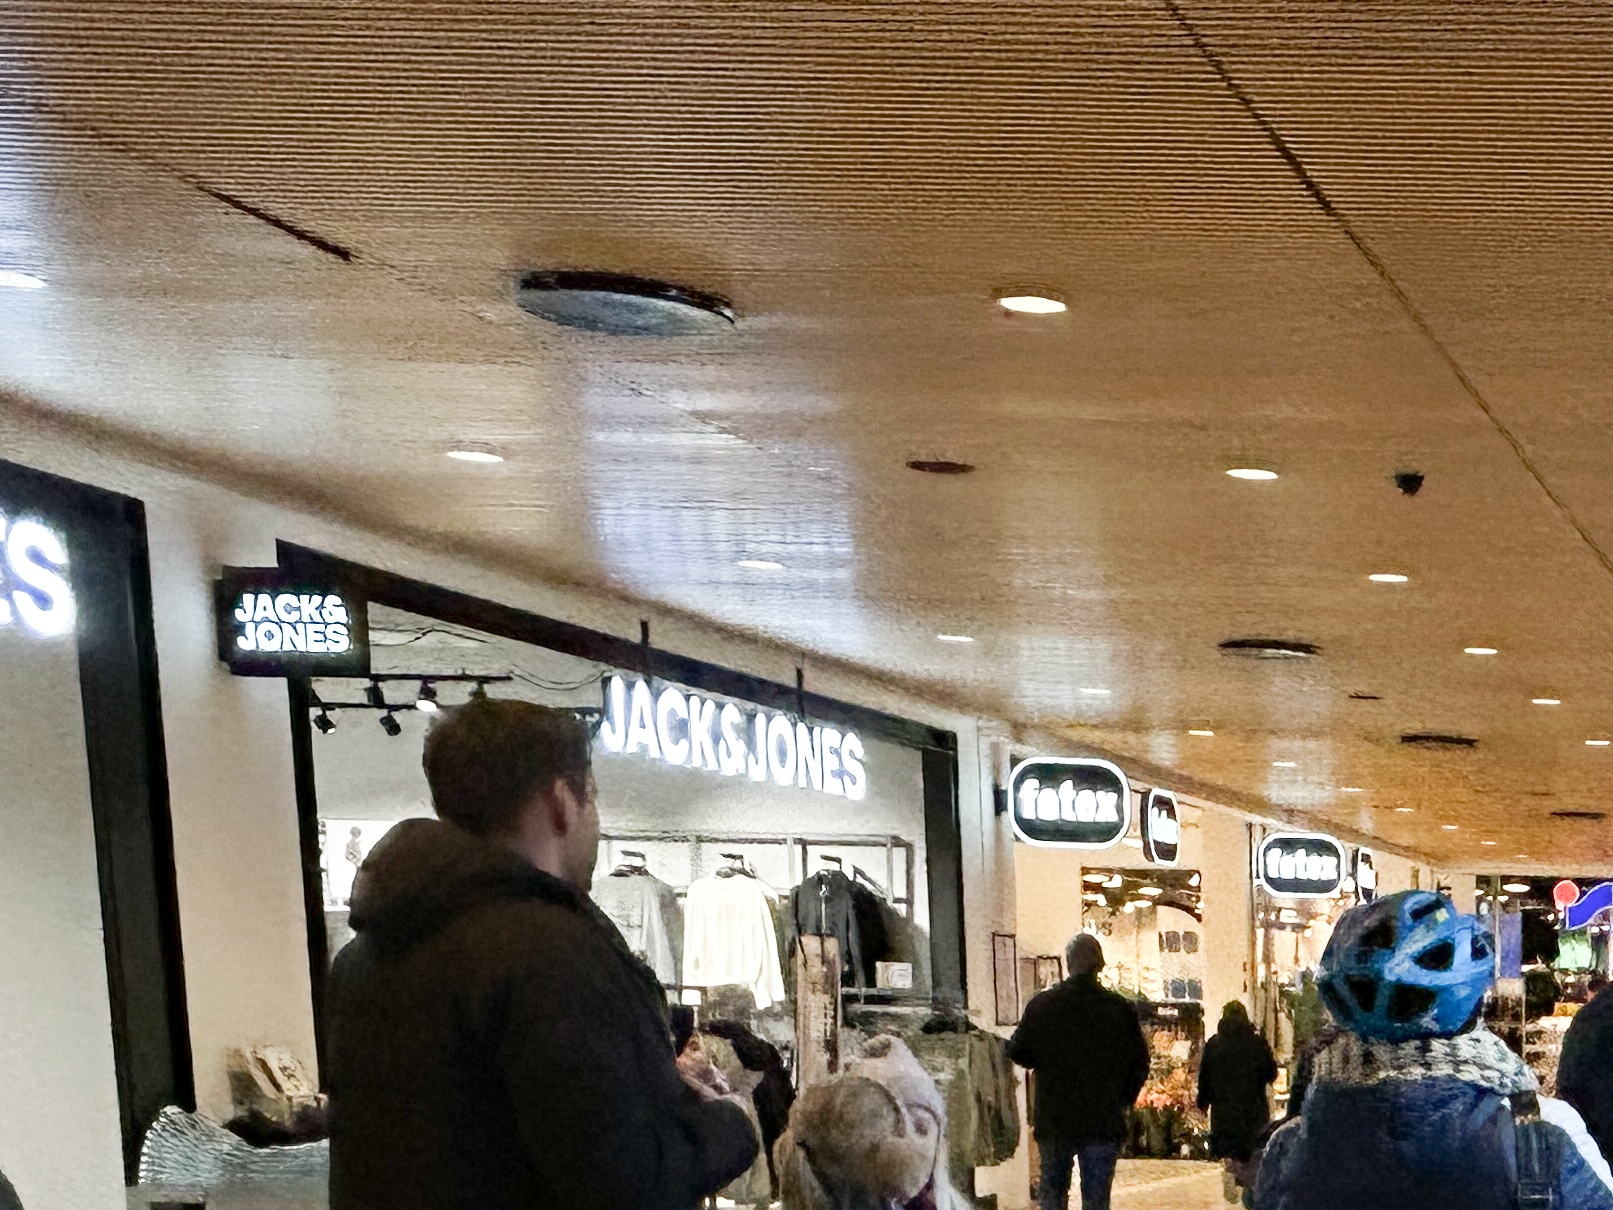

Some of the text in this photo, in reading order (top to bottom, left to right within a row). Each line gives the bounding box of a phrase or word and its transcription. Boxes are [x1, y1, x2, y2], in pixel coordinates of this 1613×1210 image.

[0, 513, 76, 637] S
[234, 593, 349, 624] JACK&
[236, 622, 352, 655] JONES
